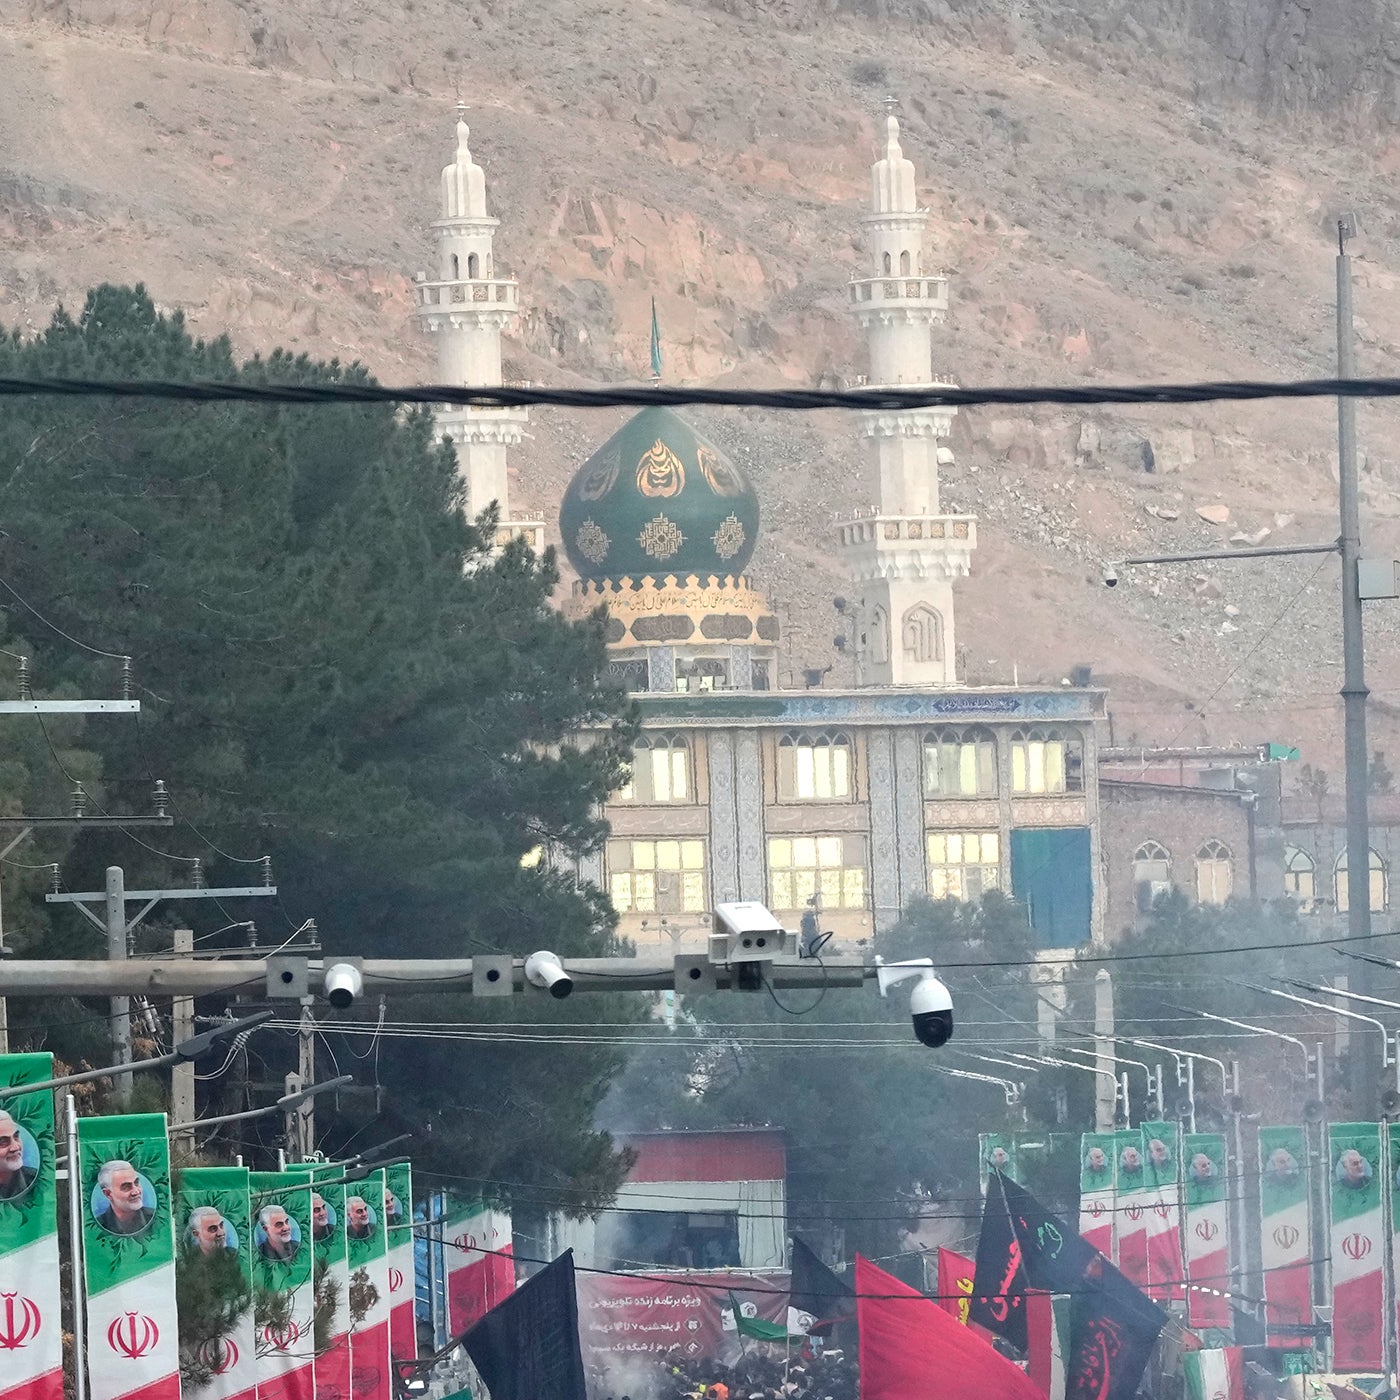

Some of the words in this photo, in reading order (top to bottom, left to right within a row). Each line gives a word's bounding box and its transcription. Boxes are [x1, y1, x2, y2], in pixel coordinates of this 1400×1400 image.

[634, 1296, 653, 1308] زنده
[654, 1295, 680, 1308] برنامه
[681, 1295, 701, 1308] ویژه
